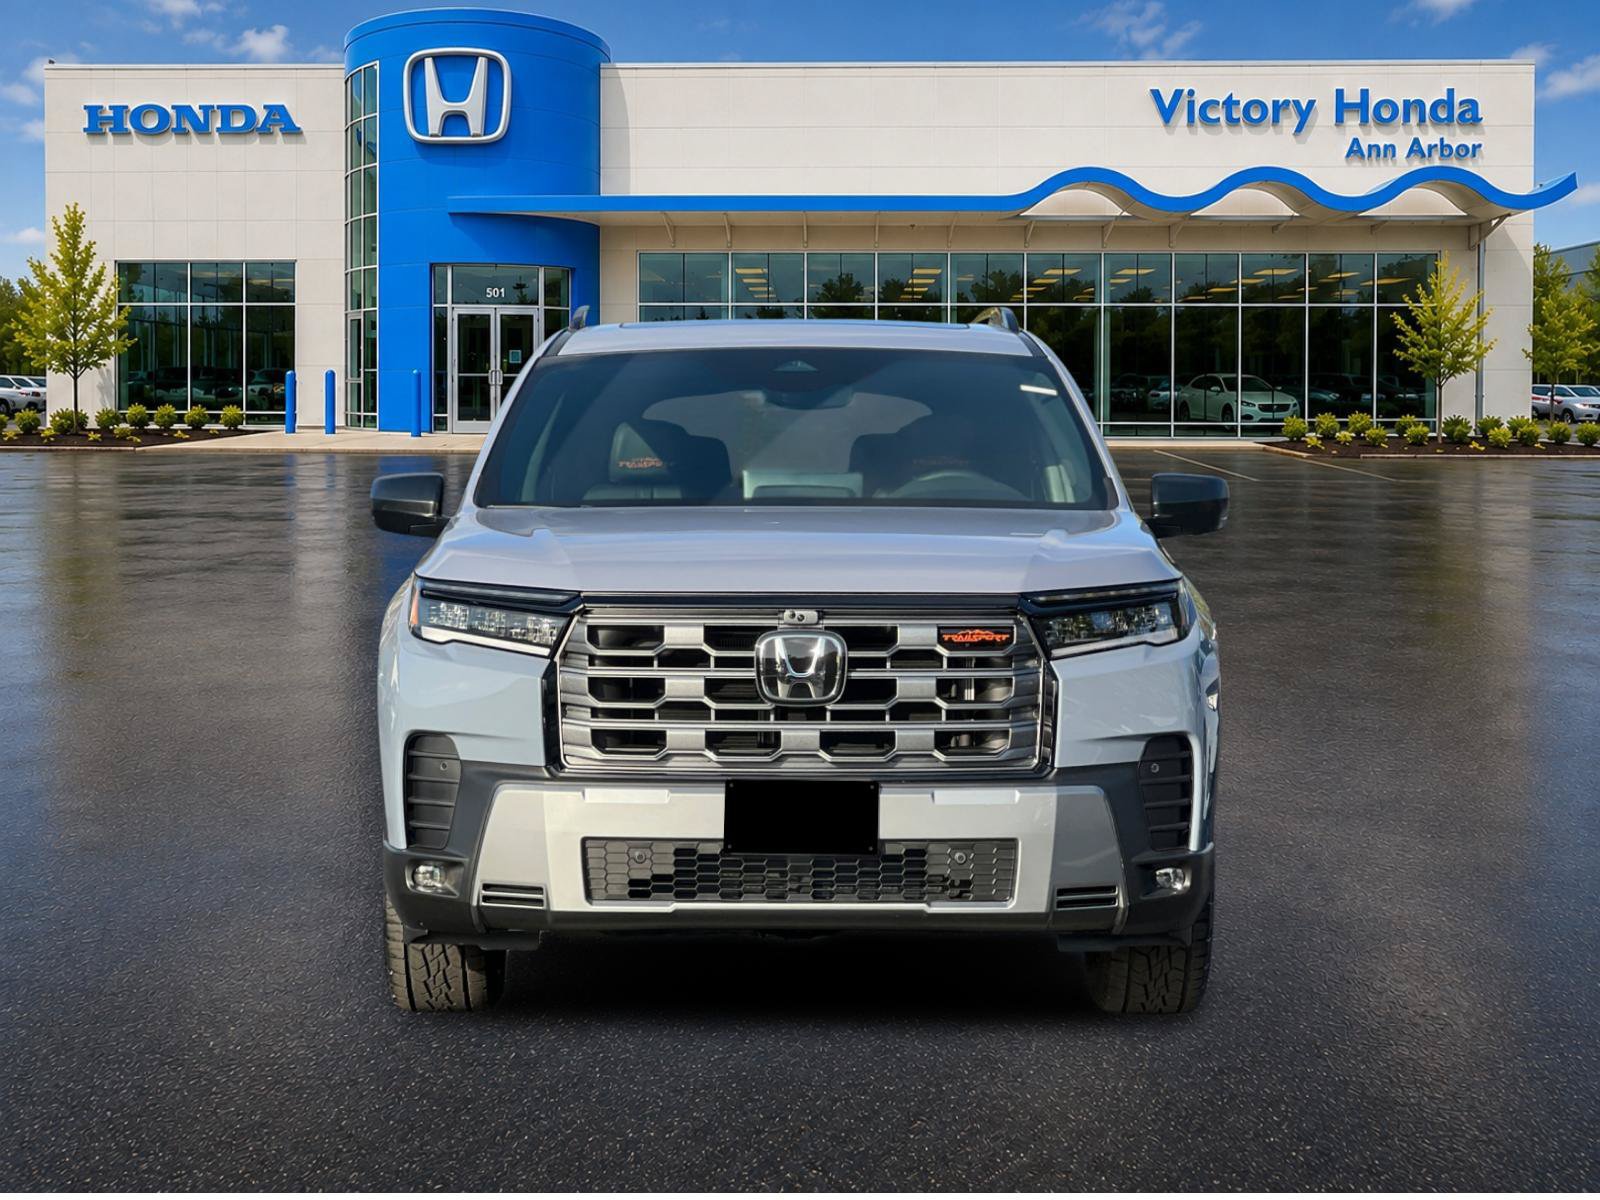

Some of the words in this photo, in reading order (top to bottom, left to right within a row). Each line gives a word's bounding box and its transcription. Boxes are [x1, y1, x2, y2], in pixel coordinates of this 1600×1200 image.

[83, 103, 303, 135] HONDA
[1150, 87, 1317, 136] Victory
[1334, 87, 1484, 126] Honda
[1345, 136, 1397, 160] Ann
[1405, 136, 1483, 160] Arbor
[485, 287, 506, 299] 501
